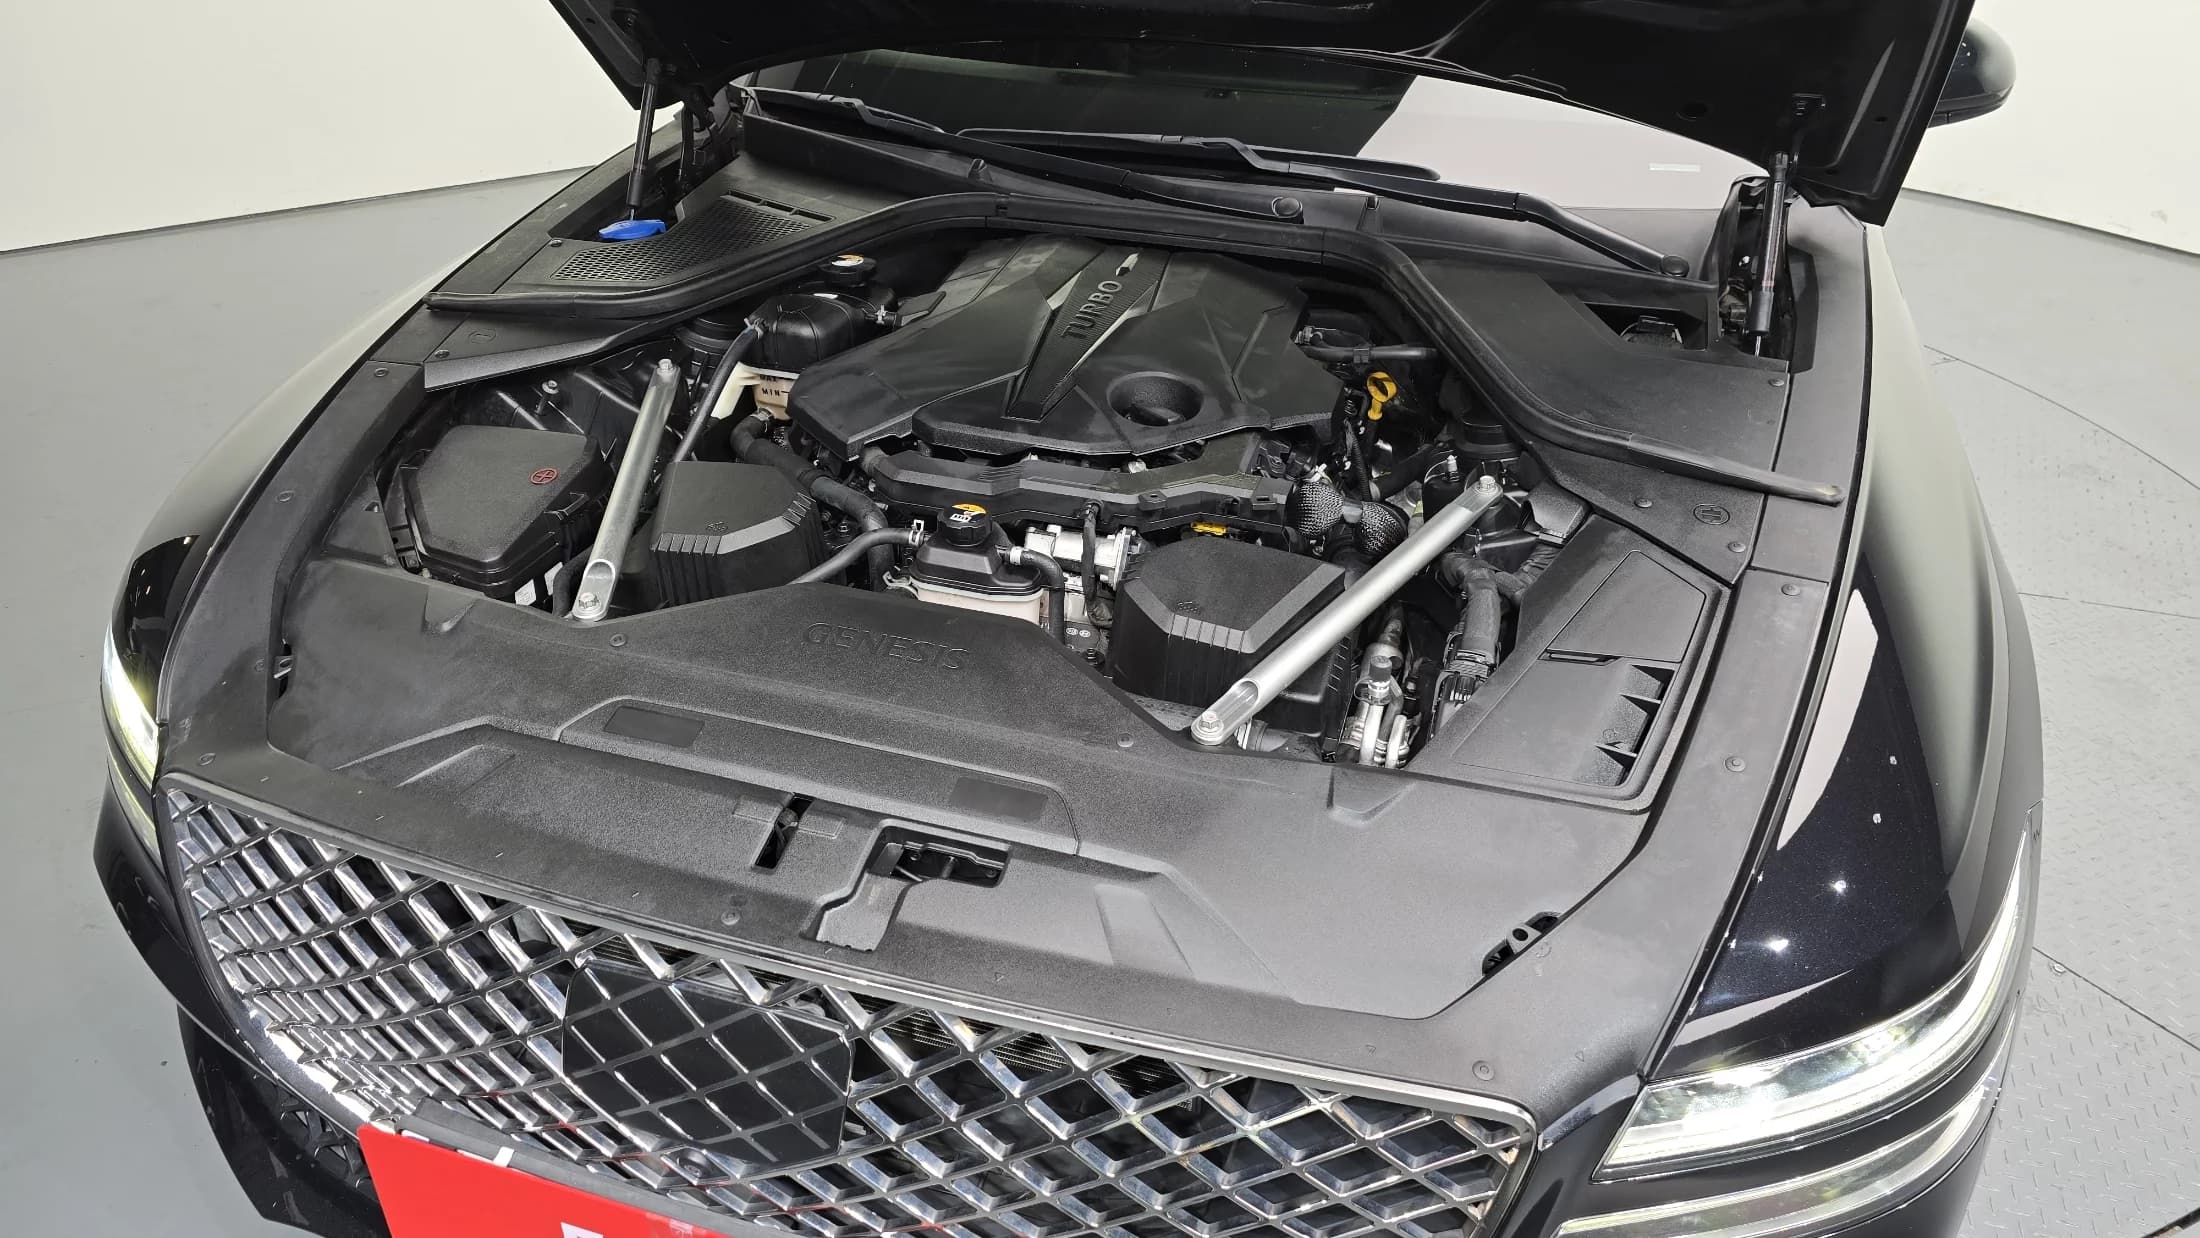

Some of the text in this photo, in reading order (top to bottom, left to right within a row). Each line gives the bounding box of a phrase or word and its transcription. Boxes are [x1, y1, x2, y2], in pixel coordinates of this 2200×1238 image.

[1060, 280, 1122, 338] TURBO
[761, 388, 780, 396] MIN
[806, 622, 970, 669] GENESIS
